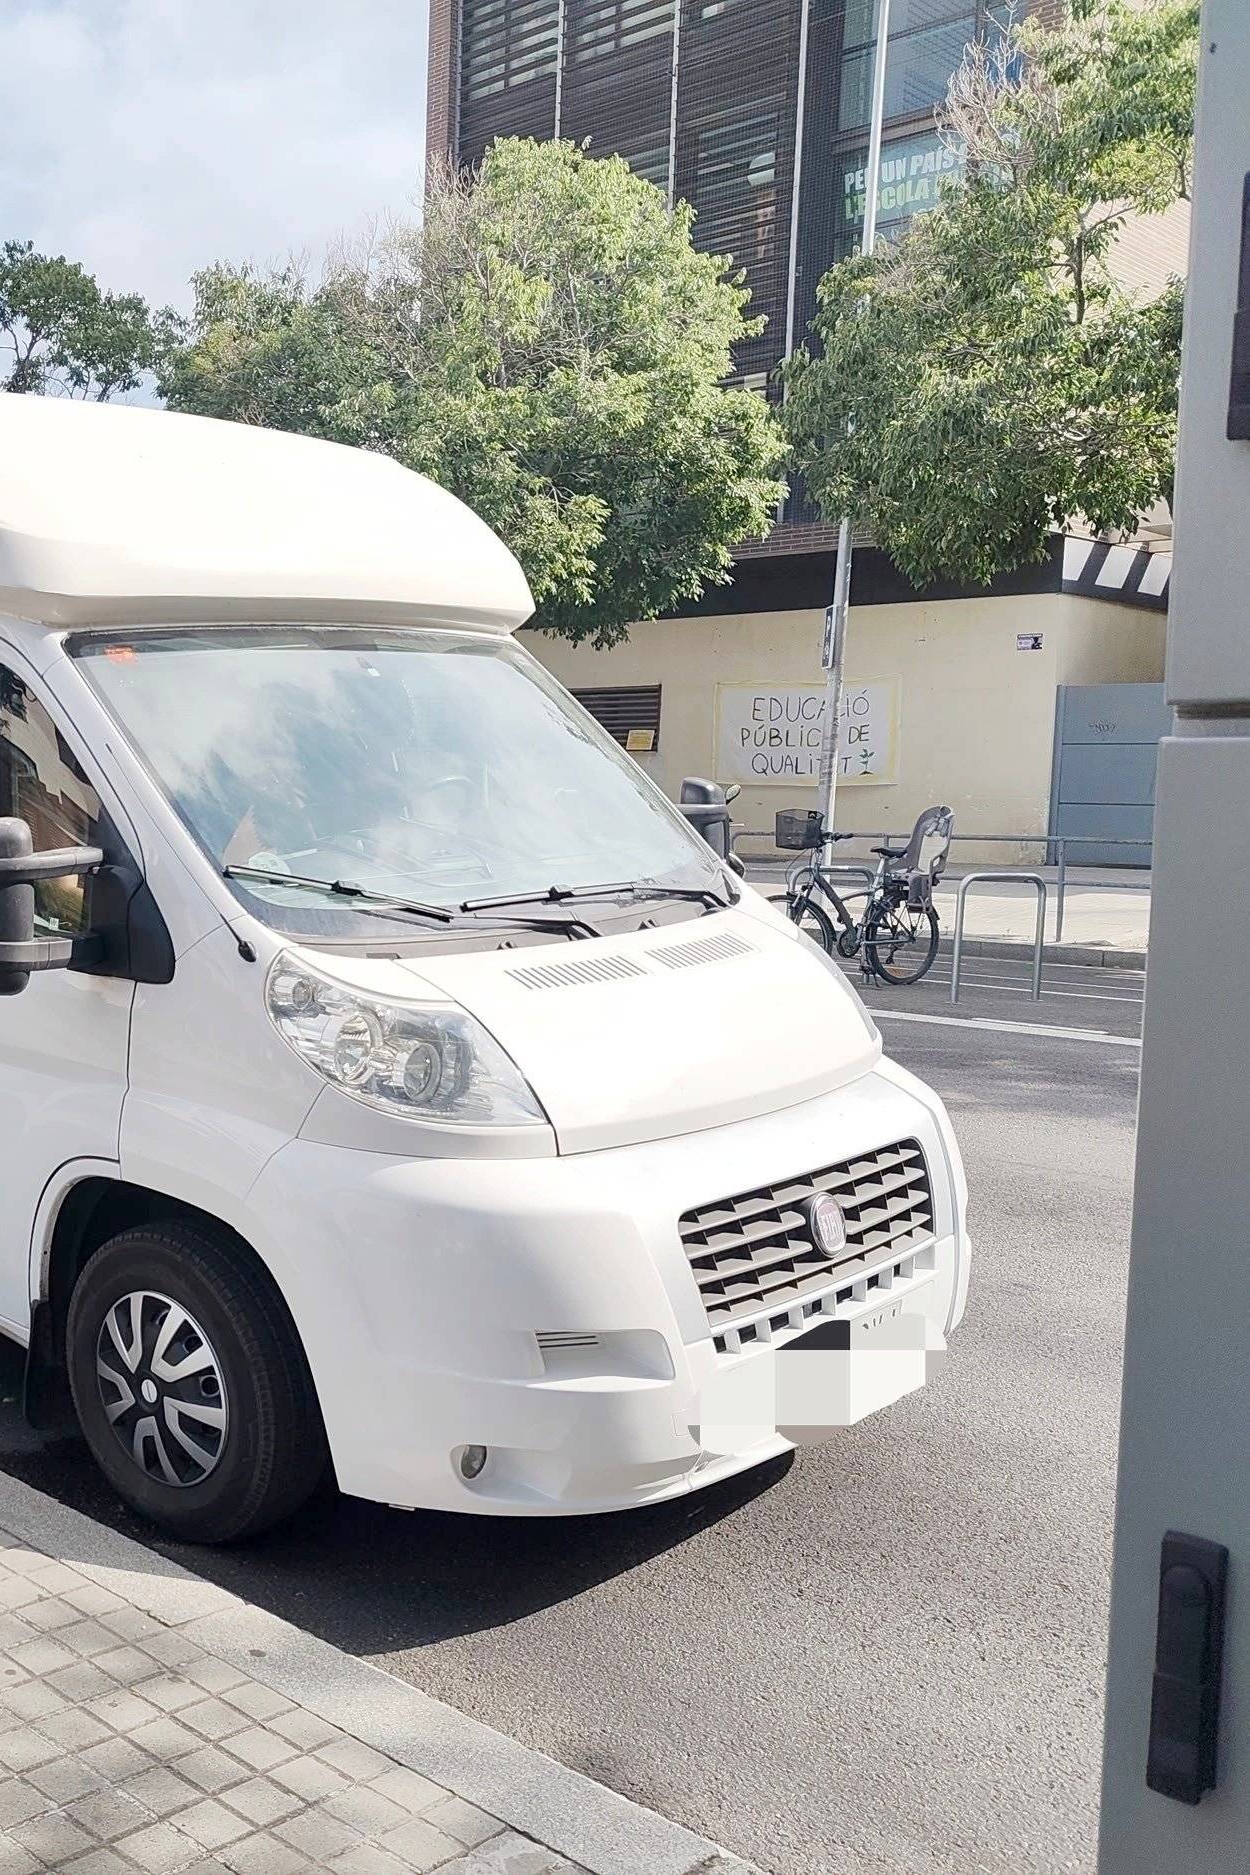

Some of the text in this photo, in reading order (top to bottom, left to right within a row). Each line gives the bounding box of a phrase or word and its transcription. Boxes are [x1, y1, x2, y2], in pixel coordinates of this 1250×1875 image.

[881, 157, 907, 183] UN
[909, 146, 953, 176] PAÍS
[845, 178, 930, 220] L'ECOLA
[752, 689, 870, 722] EDUCAIÓ
[741, 724, 870, 748] PÚBLIC DE
[751, 753, 852, 776] QUALIT
